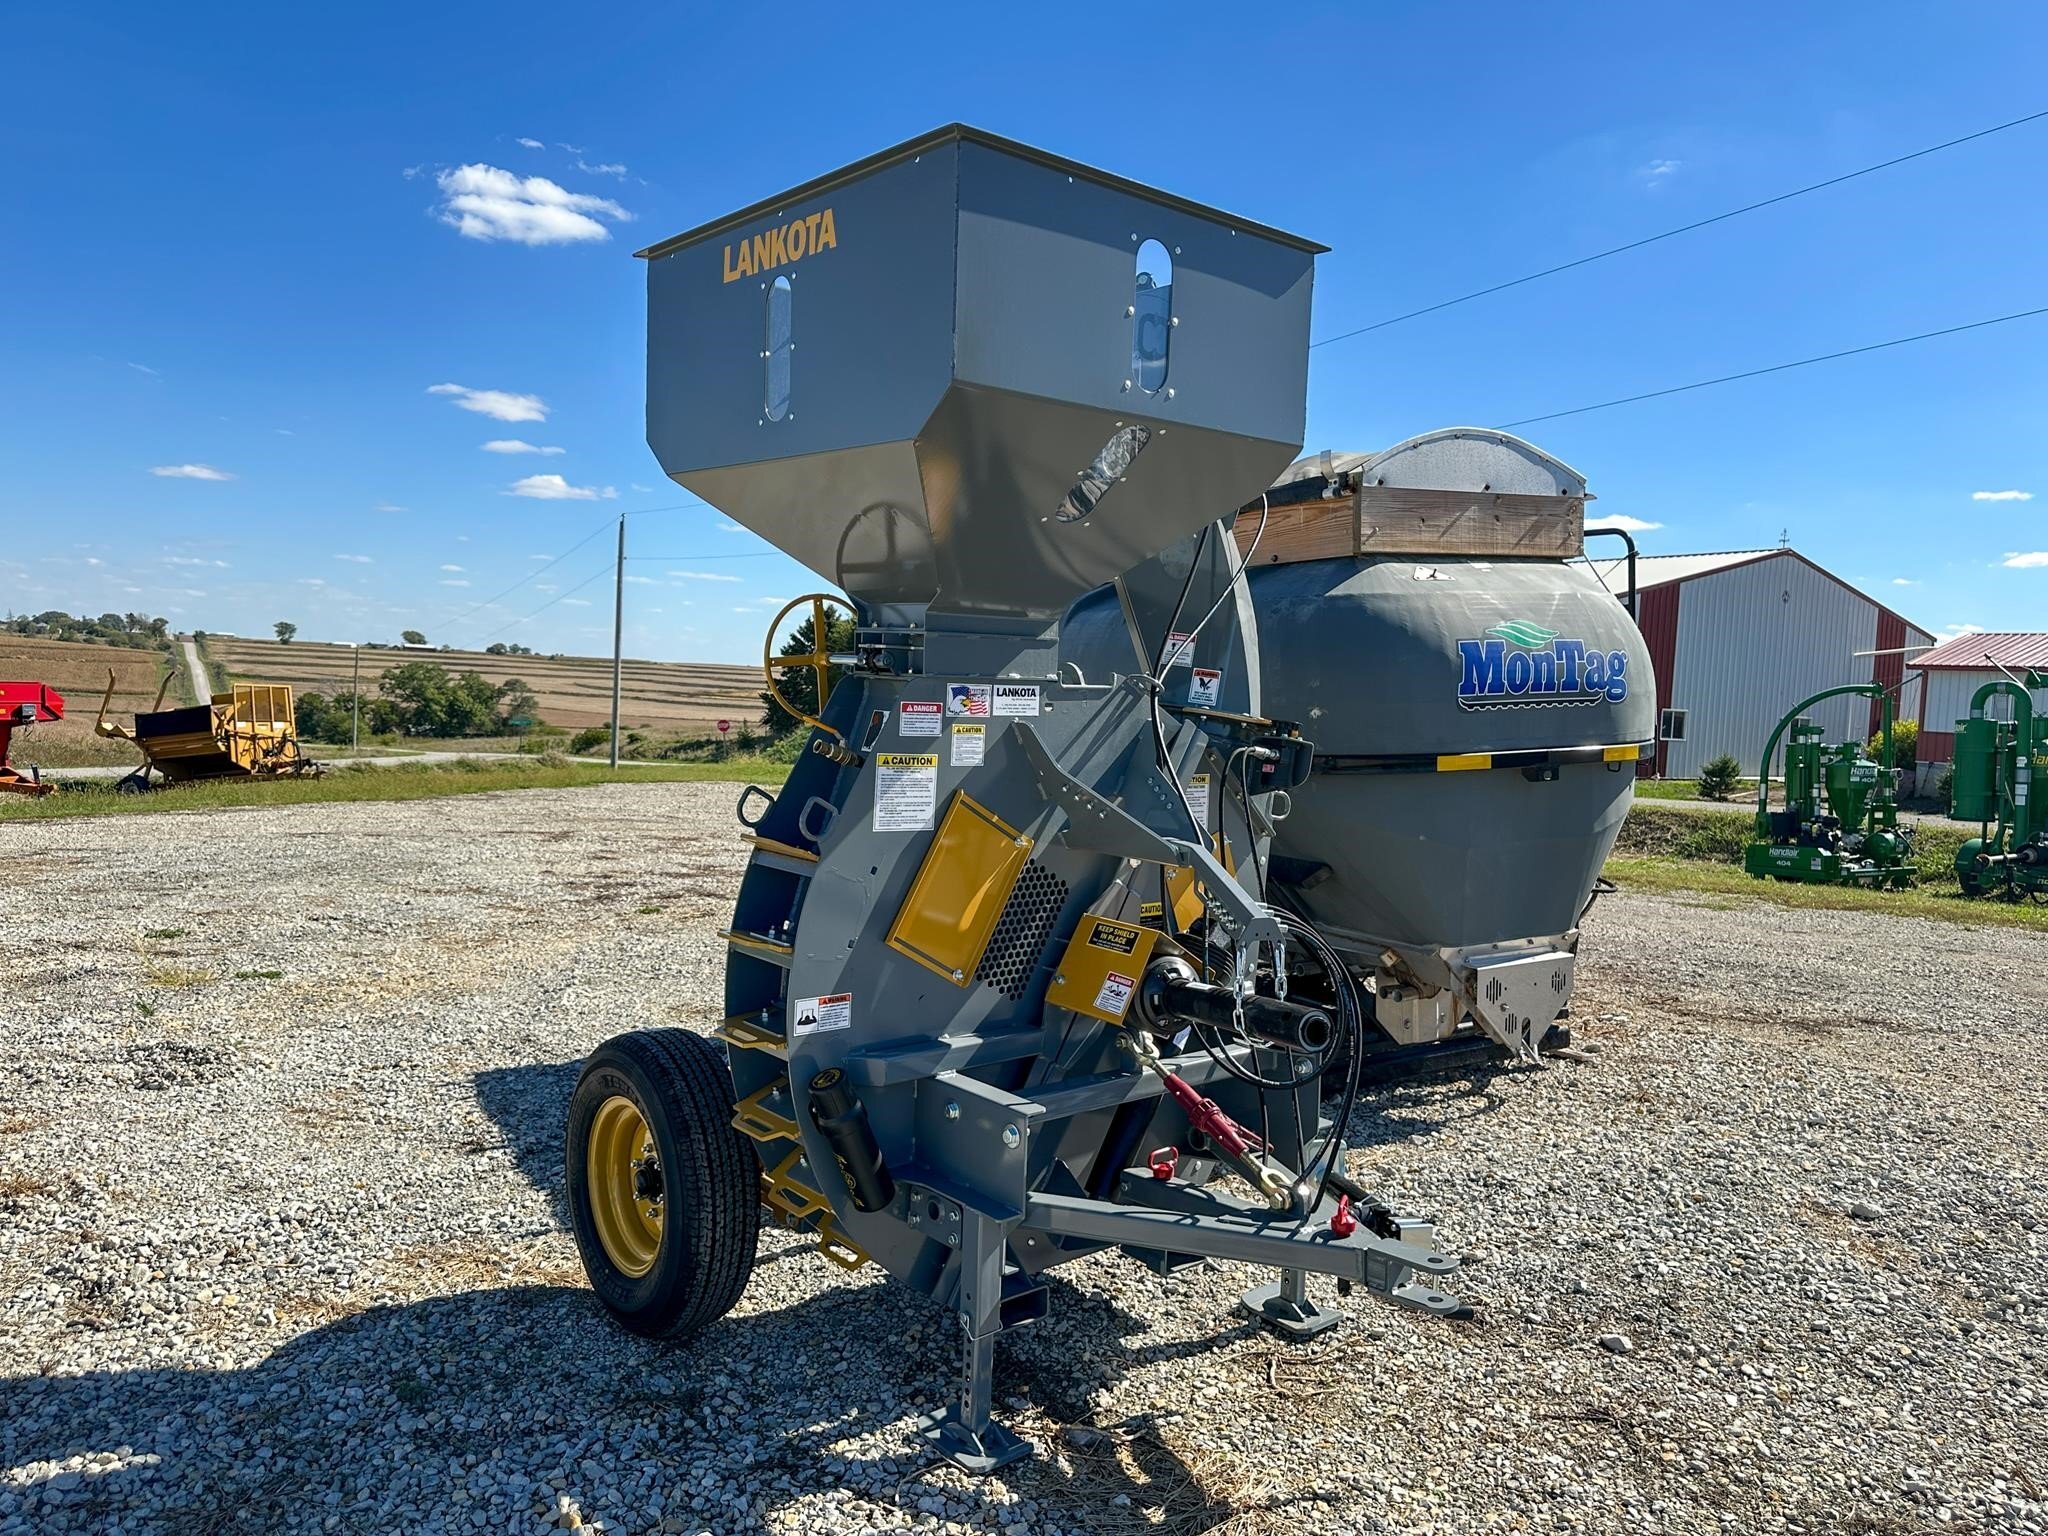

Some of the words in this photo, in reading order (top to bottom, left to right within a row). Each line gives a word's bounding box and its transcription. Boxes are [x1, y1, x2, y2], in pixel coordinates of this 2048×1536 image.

[723, 208, 837, 284] LANKOTA
[1457, 639, 1628, 703] MonTag
[996, 687, 1037, 698] LANKOTA
[891, 756, 933, 766] CAUTION
[1098, 925, 1114, 933] KEEP
[1114, 928, 1135, 939] SHIELD
[1108, 934, 1127, 945] PLACE
